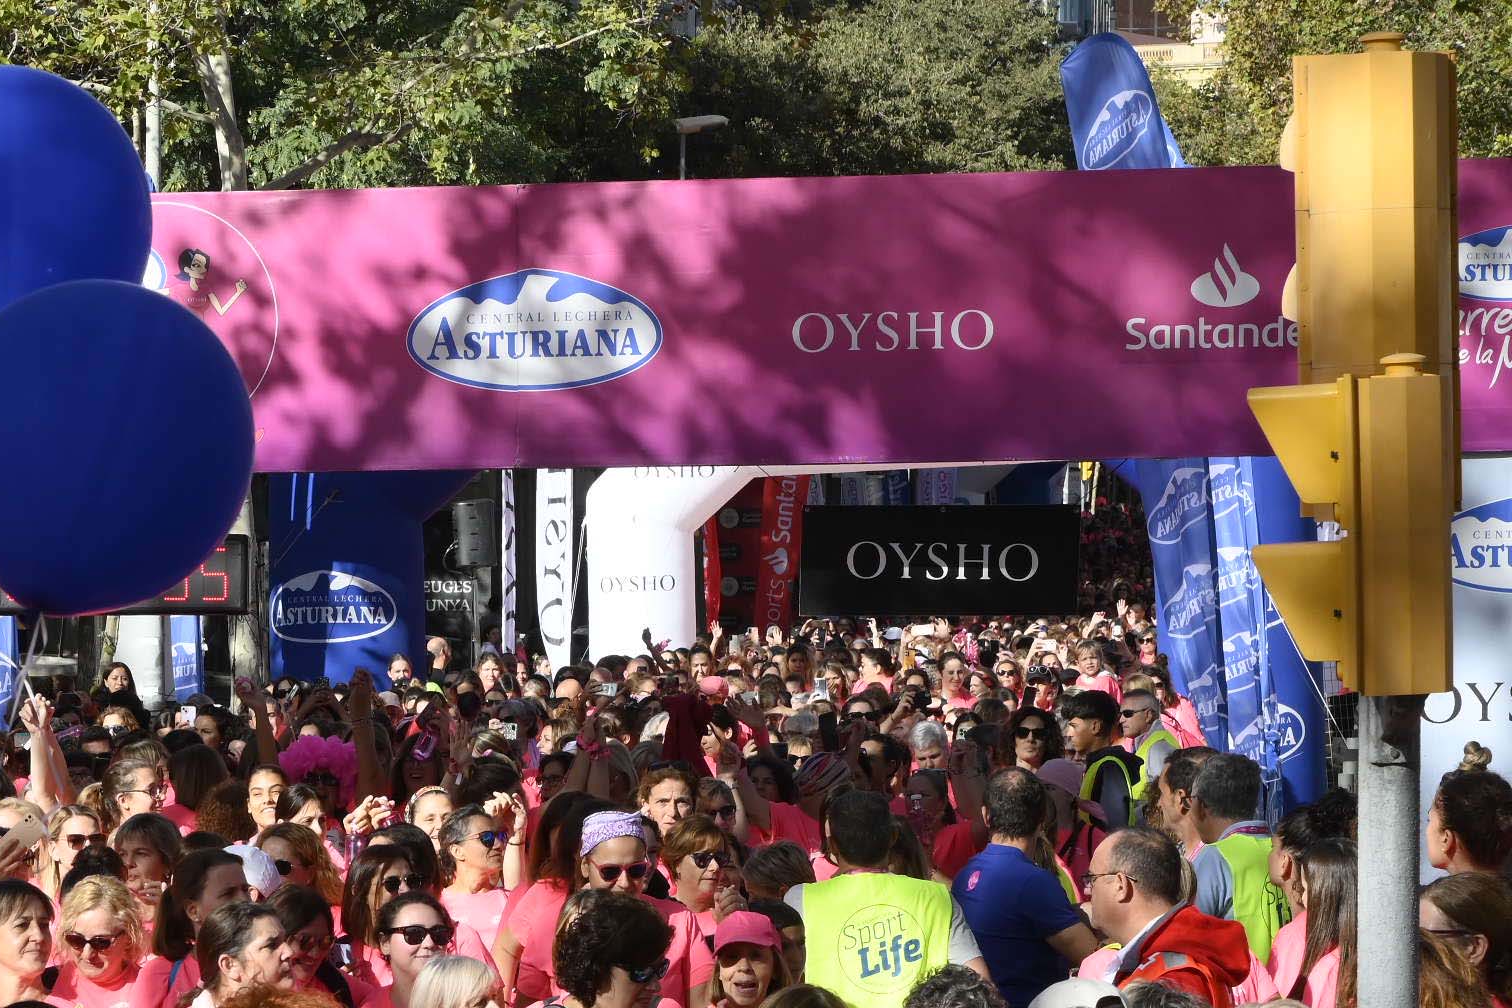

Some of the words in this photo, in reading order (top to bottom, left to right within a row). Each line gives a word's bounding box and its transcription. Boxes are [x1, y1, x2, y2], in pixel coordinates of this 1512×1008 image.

[1459, 264, 1512, 282] STU
[466, 312, 545, 325] CENTRAL
[553, 310, 633, 323] LECHERA
[791, 309, 994, 353] OYSHO
[1125, 316, 1300, 351] Santande
[1459, 307, 1512, 336] rre
[426, 316, 642, 361] ASTURIANA
[772, 475, 798, 544] Santa
[846, 541, 1039, 584] OYSHO
[600, 574, 676, 592] OYSHO
[276, 599, 388, 627] ASTURIANA
[843, 911, 906, 951] Sport
[858, 934, 923, 979] Life
